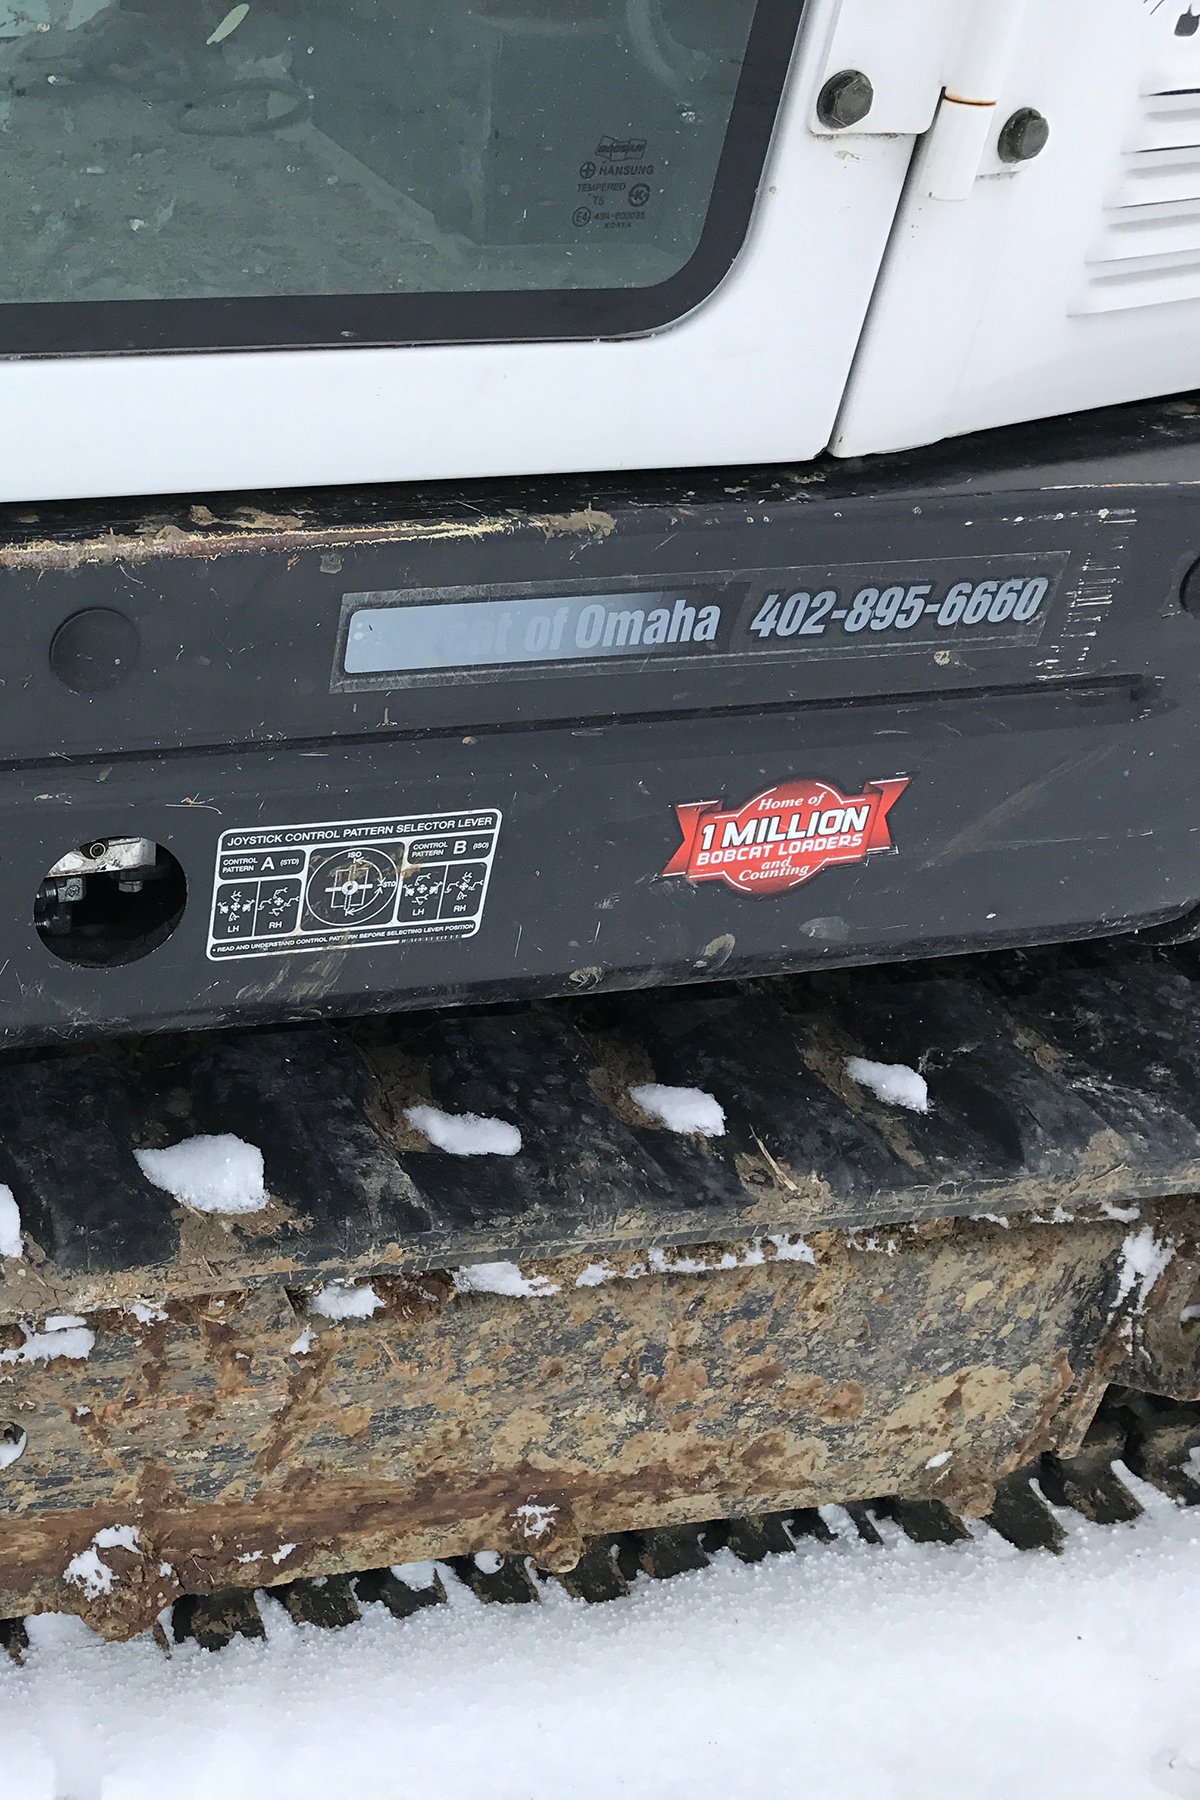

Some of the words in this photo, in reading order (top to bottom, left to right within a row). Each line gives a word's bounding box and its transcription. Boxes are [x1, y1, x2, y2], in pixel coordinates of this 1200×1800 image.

[599, 165, 654, 176] HANSUNG
[577, 182, 626, 192] TEMPERED
[524, 606, 570, 652] of
[574, 599, 721, 649] Omaha
[750, 577, 1049, 638] 402-895-6660
[757, 796, 804, 812] Home
[807, 791, 827, 806] of
[227, 834, 283, 847] JOYSTICK
[285, 830, 340, 842] CONTROL
[343, 825, 394, 838] PATTERN
[396, 820, 456, 834] SELECTOR
[458, 816, 492, 828] LEVER
[701, 823, 715, 850] 1
[720, 805, 870, 849] MILLION
[412, 842, 448, 850] CONTROL
[453, 840, 467, 854] B
[472, 842, 490, 850] (ISO)
[696, 844, 774, 866] BOBCAT
[778, 832, 864, 856] LOADERS
[411, 850, 444, 858] PATTERN
[222, 858, 258, 866] CONTROL
[260, 856, 275, 871] A
[280, 858, 300, 866] (STD)
[761, 856, 792, 869] and
[222, 866, 255, 874] PATTERN
[739, 864, 811, 882] Counting
[412, 908, 425, 916] LH
[453, 904, 467, 912] RH
[227, 925, 240, 933] LH
[268, 921, 282, 929] RH
[250, 939, 295, 950] UNDERSTAND
[296, 936, 328, 945] CONTROL
[329, 934, 358, 942] PATTRN
[358, 931, 386, 939] BEFORE
[386, 928, 422, 937] SELECTING
[424, 926, 444, 934] LEVER
[445, 924, 474, 932] POSITION
